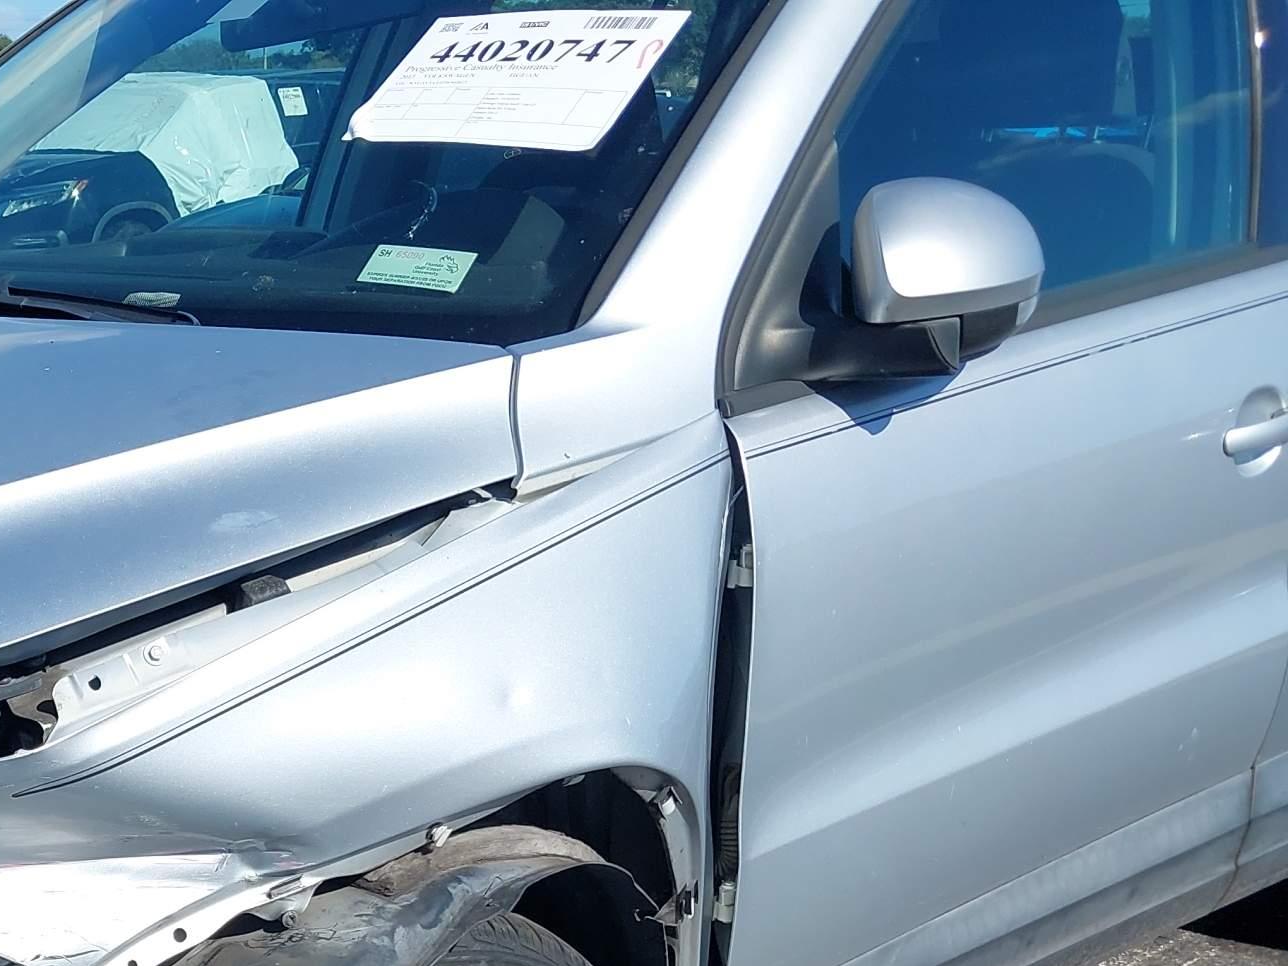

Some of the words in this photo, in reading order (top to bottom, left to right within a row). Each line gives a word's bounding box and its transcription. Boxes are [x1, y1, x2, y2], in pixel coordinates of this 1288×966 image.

[431, 38, 637, 63] 44020747
[463, 62, 503, 73] Casualty
[508, 62, 560, 72] Insurance
[378, 249, 393, 257] SH
